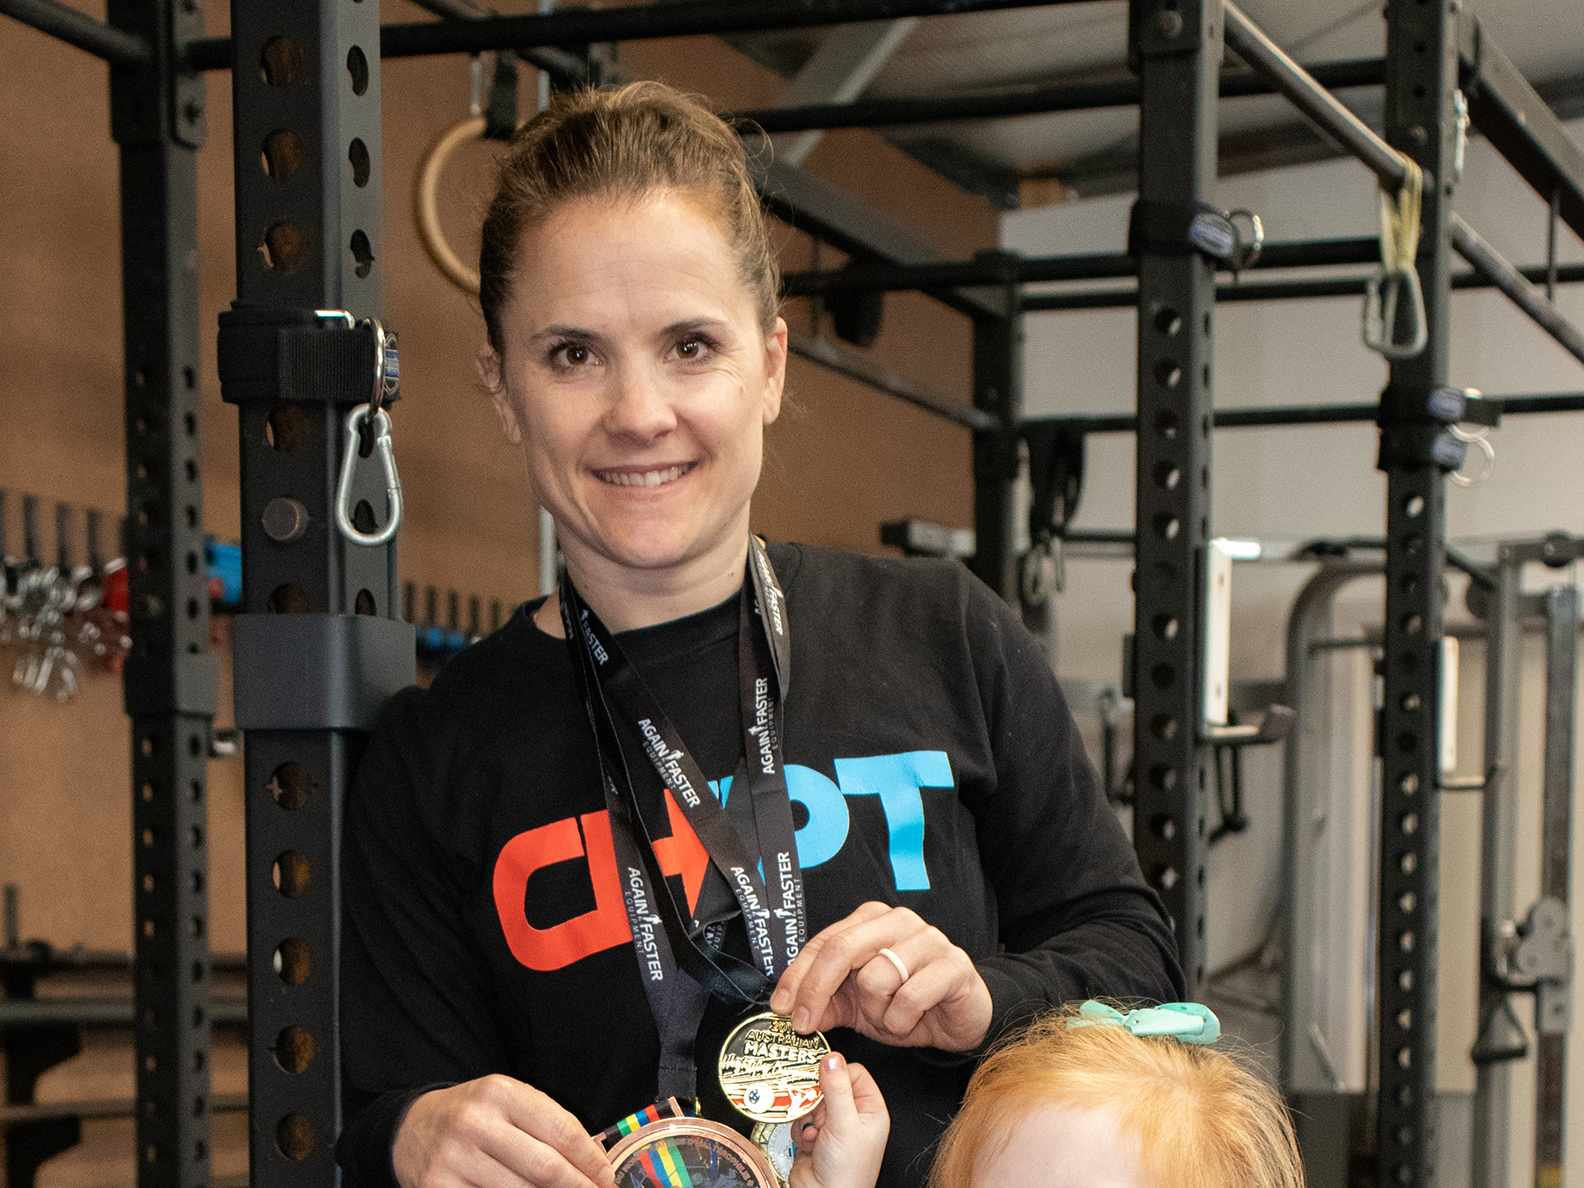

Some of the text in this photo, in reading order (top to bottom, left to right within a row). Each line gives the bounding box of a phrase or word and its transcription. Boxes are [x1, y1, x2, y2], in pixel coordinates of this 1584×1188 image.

[767, 587, 784, 636] FASTER
[583, 621, 610, 666] FASTER
[755, 677, 776, 775] AGAIN FASTER
[638, 718, 701, 808] AGAIN FASTER
[642, 741, 677, 791] EQUIPMENT
[730, 866, 762, 912] AGAIN
[777, 851, 797, 912] FASTER
[794, 878, 807, 943] EQUIPMENT
[624, 890, 645, 955] EQUIPMENT
[626, 866, 664, 982] AGAIN FASTER
[735, 888, 760, 951] EQUIPMENT
[743, 1041, 819, 1064] MASTERS
[745, 1030, 819, 1049] AUSTRALIAN
